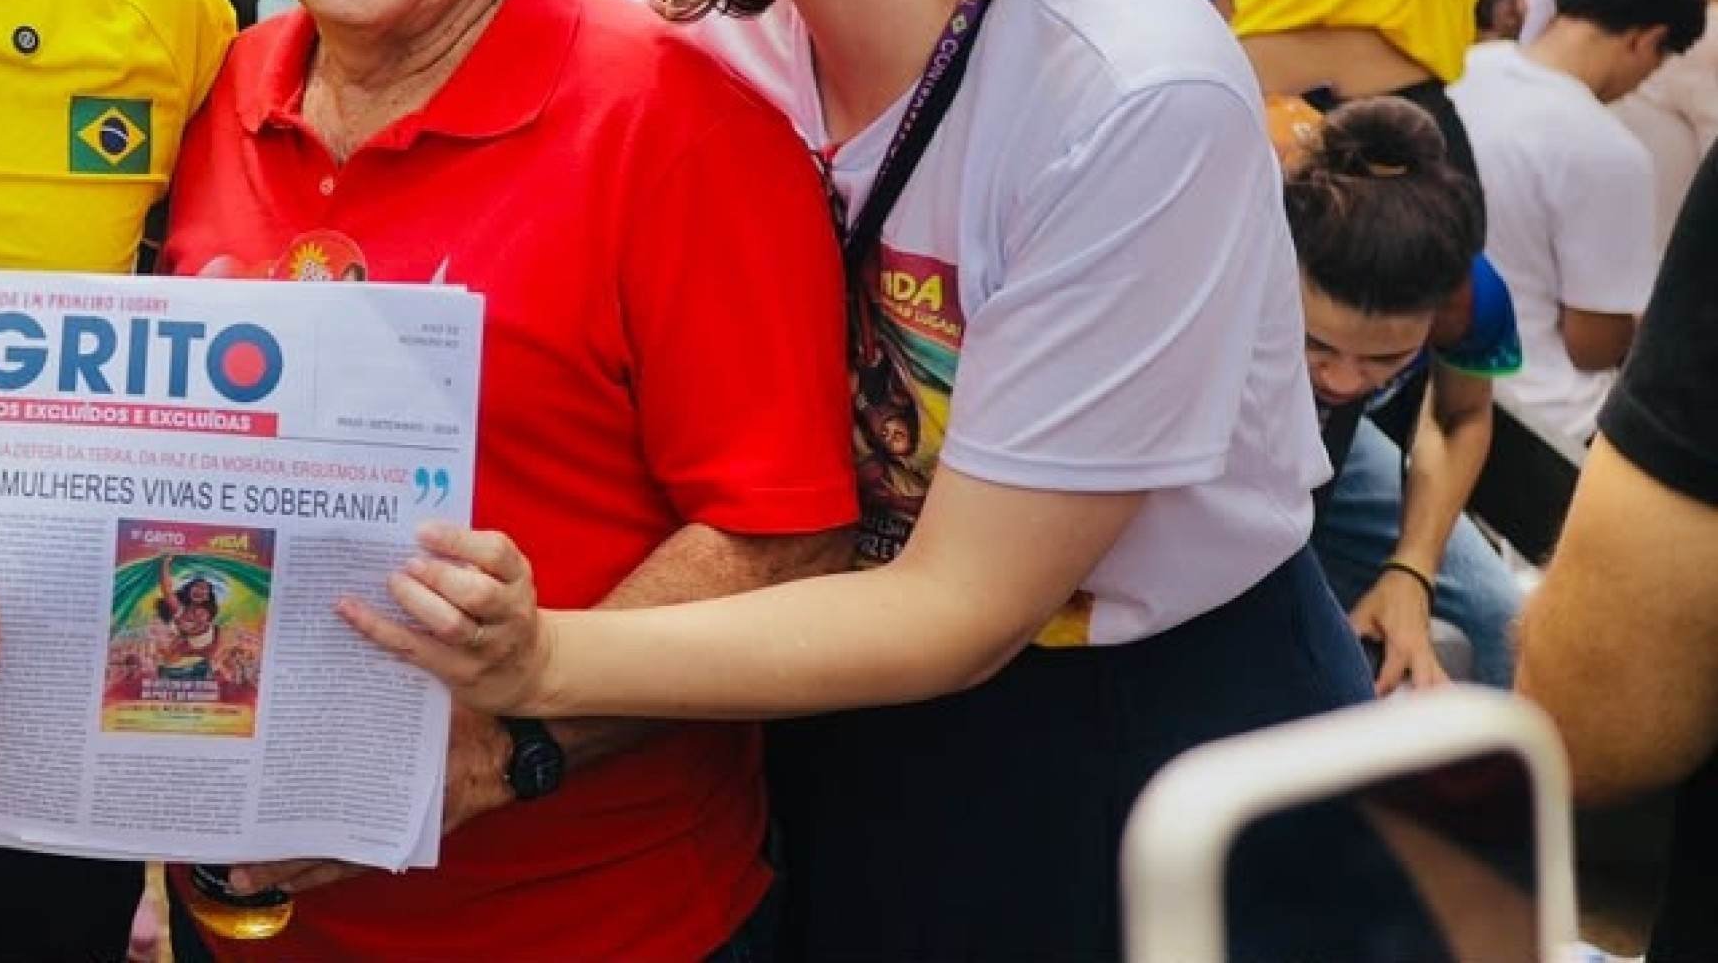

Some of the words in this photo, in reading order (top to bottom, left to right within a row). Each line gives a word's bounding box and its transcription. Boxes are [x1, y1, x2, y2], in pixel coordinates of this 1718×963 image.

[880, 270, 942, 312] IDA
[23, 400, 130, 423] EXCLUÍDOS
[133, 408, 144, 424] E
[149, 409, 251, 432] EXCLUÍDAS
[67, 445, 85, 460] DA
[139, 449, 157, 464] DA
[160, 450, 186, 467] PAZ
[201, 454, 218, 469] DA
[292, 461, 366, 483] ERGUEMOS
[369, 466, 379, 482] A
[382, 466, 409, 485] VOZ
[0, 469, 135, 506] MULHERES
[142, 477, 213, 510] VIVAS
[220, 484, 237, 513] E
[244, 484, 399, 524] SOBERANIA!
